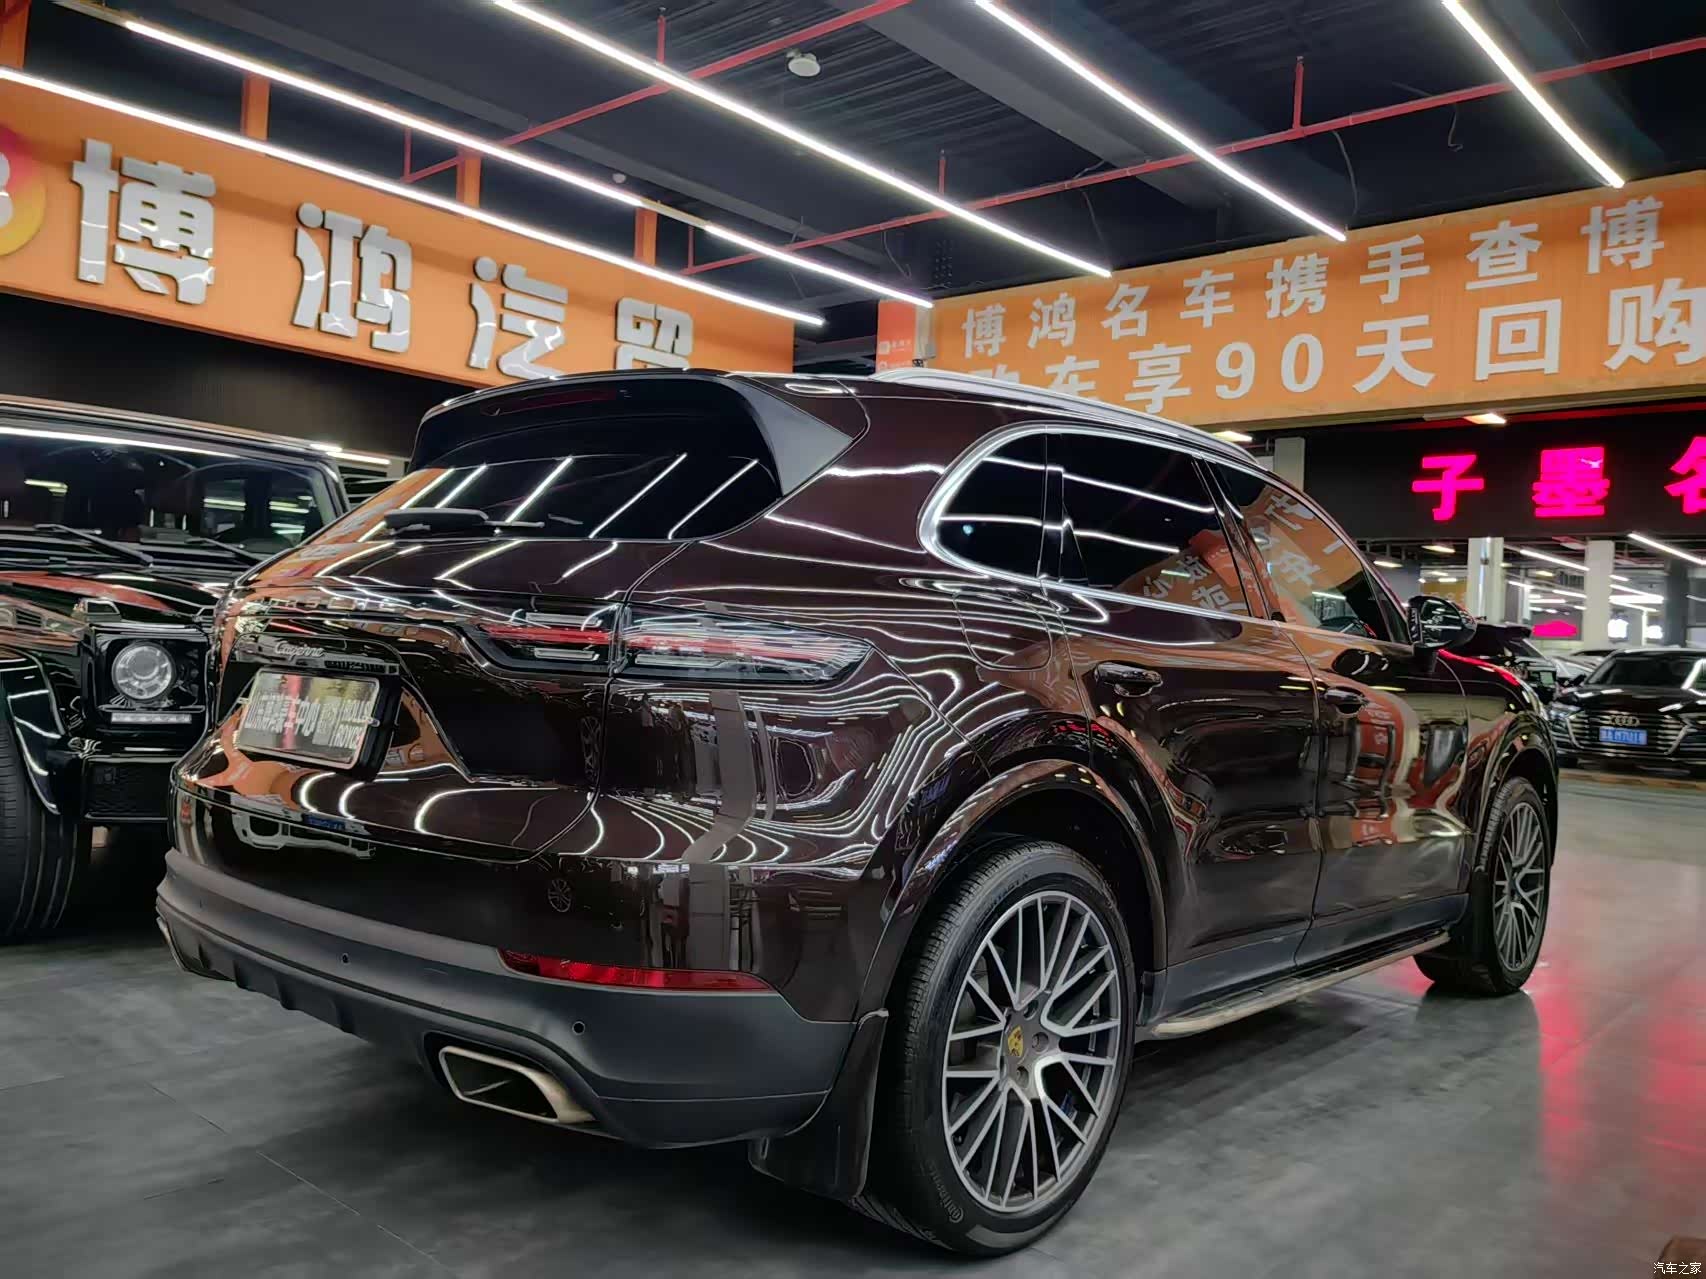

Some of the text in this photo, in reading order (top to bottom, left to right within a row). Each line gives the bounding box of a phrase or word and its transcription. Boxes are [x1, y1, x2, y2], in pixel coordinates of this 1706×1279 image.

[961, 196, 1665, 358] 博鸿名车携手查博
[274, 640, 326, 662] Cayenne
